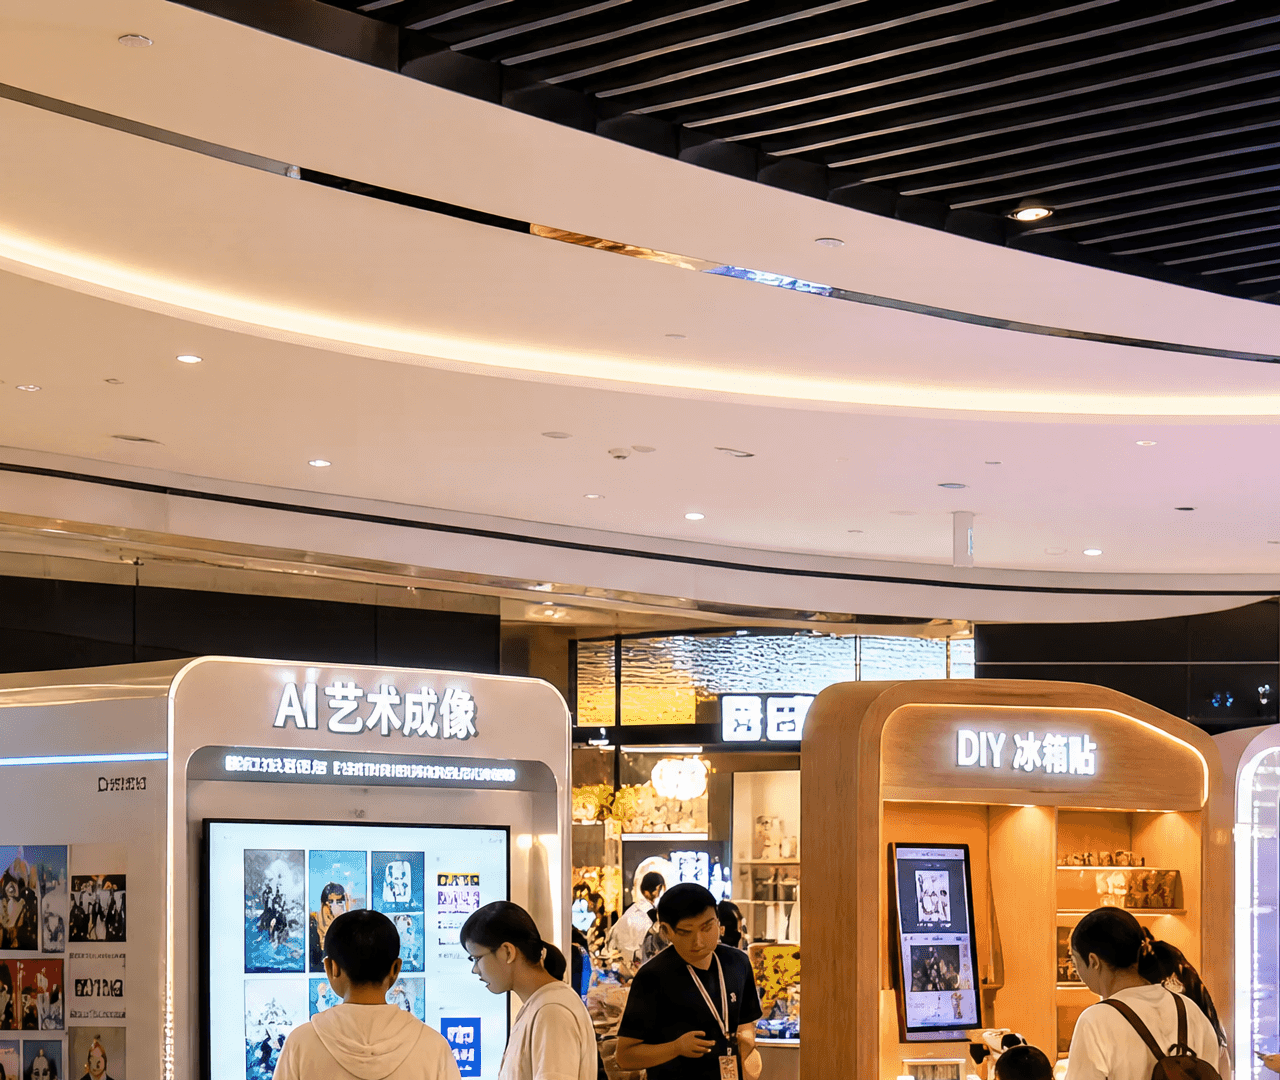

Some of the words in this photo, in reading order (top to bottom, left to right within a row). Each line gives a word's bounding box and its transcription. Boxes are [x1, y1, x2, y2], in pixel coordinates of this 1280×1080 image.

[273, 682, 318, 729] AI
[324, 681, 478, 740] 艺术成像
[957, 729, 1007, 768] DIY
[1012, 731, 1097, 776] 冰箱贴
